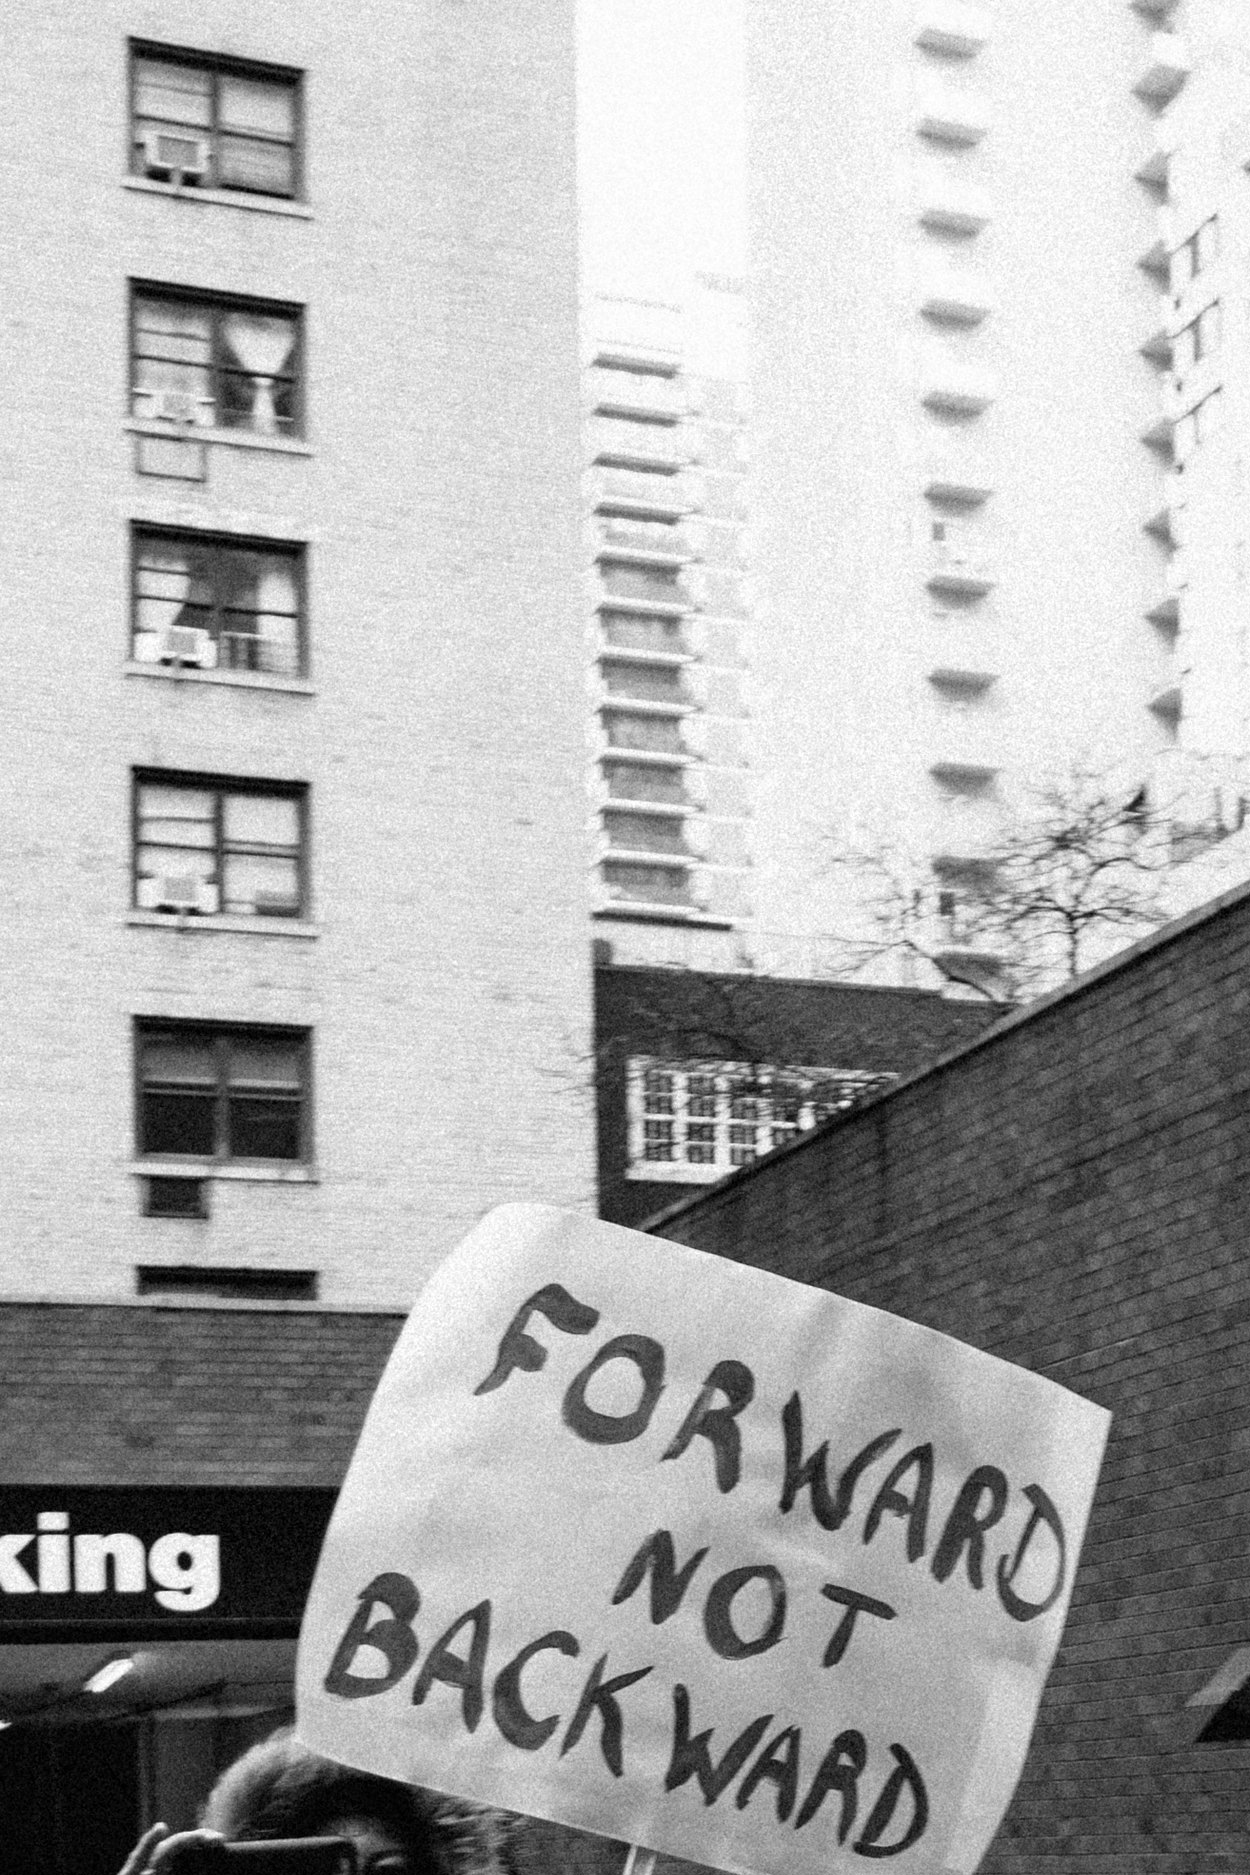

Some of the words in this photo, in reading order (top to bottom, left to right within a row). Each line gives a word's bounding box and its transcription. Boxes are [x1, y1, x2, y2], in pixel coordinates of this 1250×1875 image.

[474, 1284, 1067, 1622] FORWARD
[324, 1572, 930, 1858] BACKWARD
[612, 1530, 897, 1668] NOT
